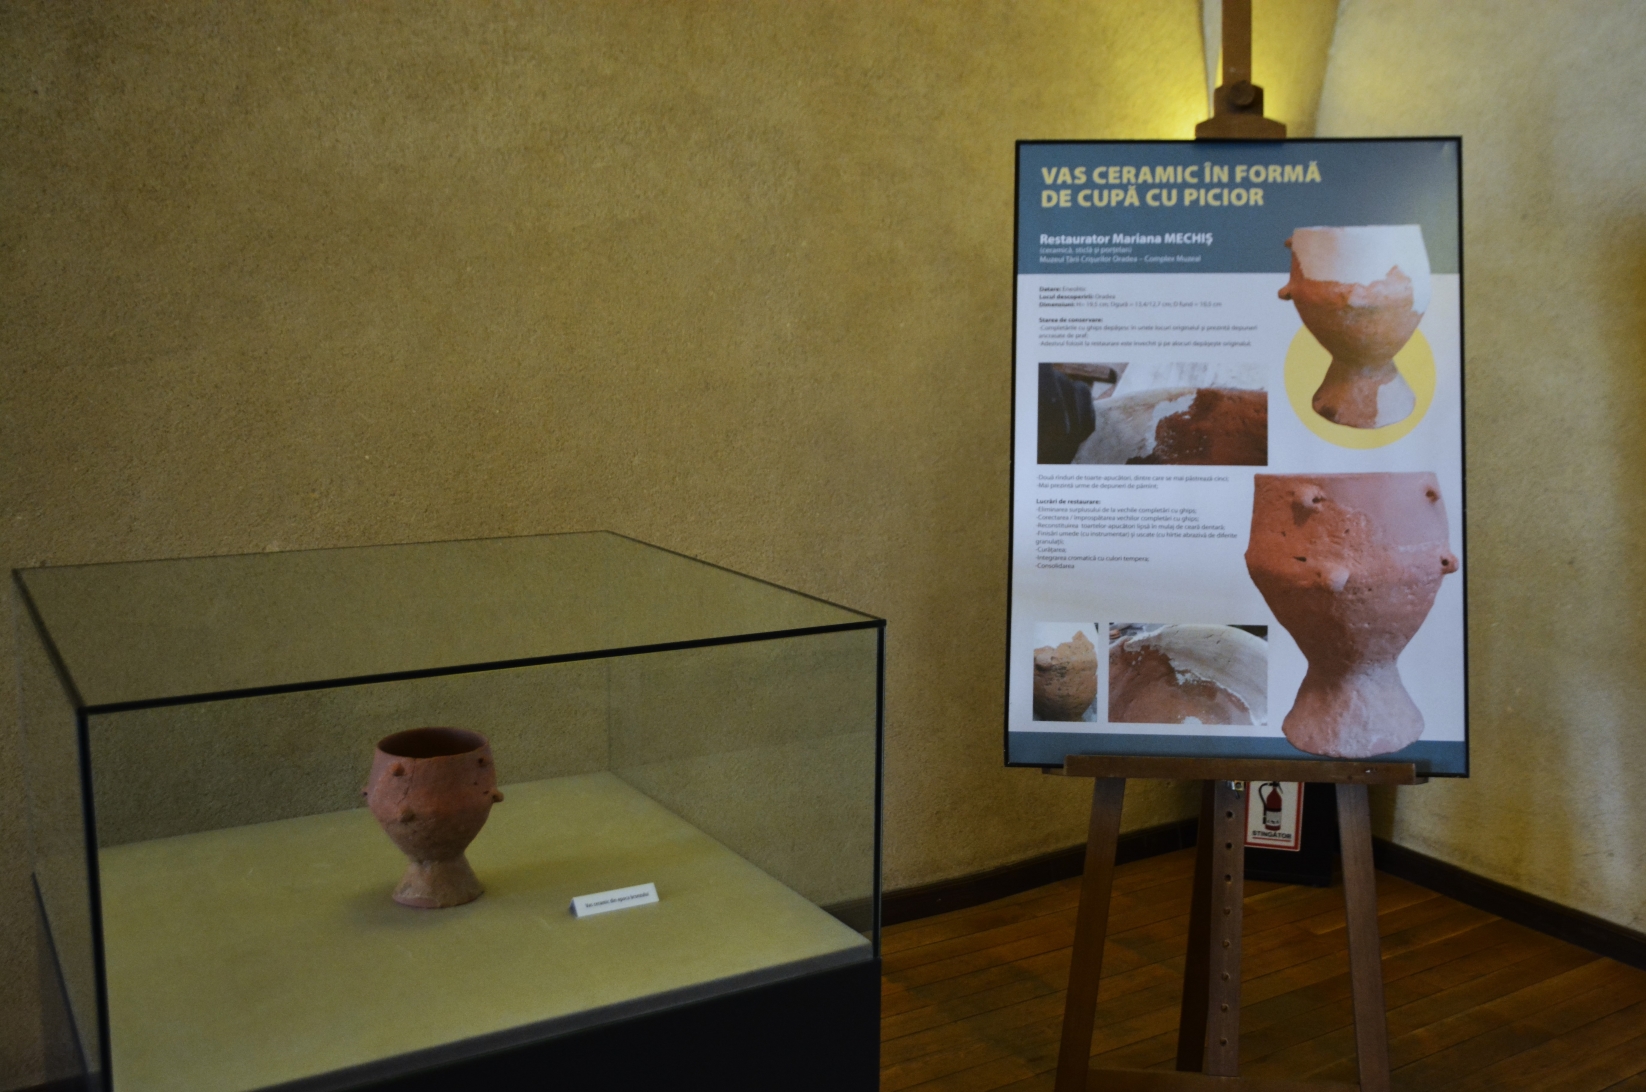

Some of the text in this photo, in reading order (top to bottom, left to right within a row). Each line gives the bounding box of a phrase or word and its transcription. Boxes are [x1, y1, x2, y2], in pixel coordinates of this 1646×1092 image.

[1041, 161, 1321, 185] VAS CERAMIC ÎN FORMĂ
[1041, 185, 1264, 208] DE CUPĂ CU PICIOR
[1040, 233, 1110, 245] Restaurator
[1112, 233, 1161, 244] Mariana
[1112, 255, 1138, 263] Oradea
[1144, 255, 1175, 263] Complex
